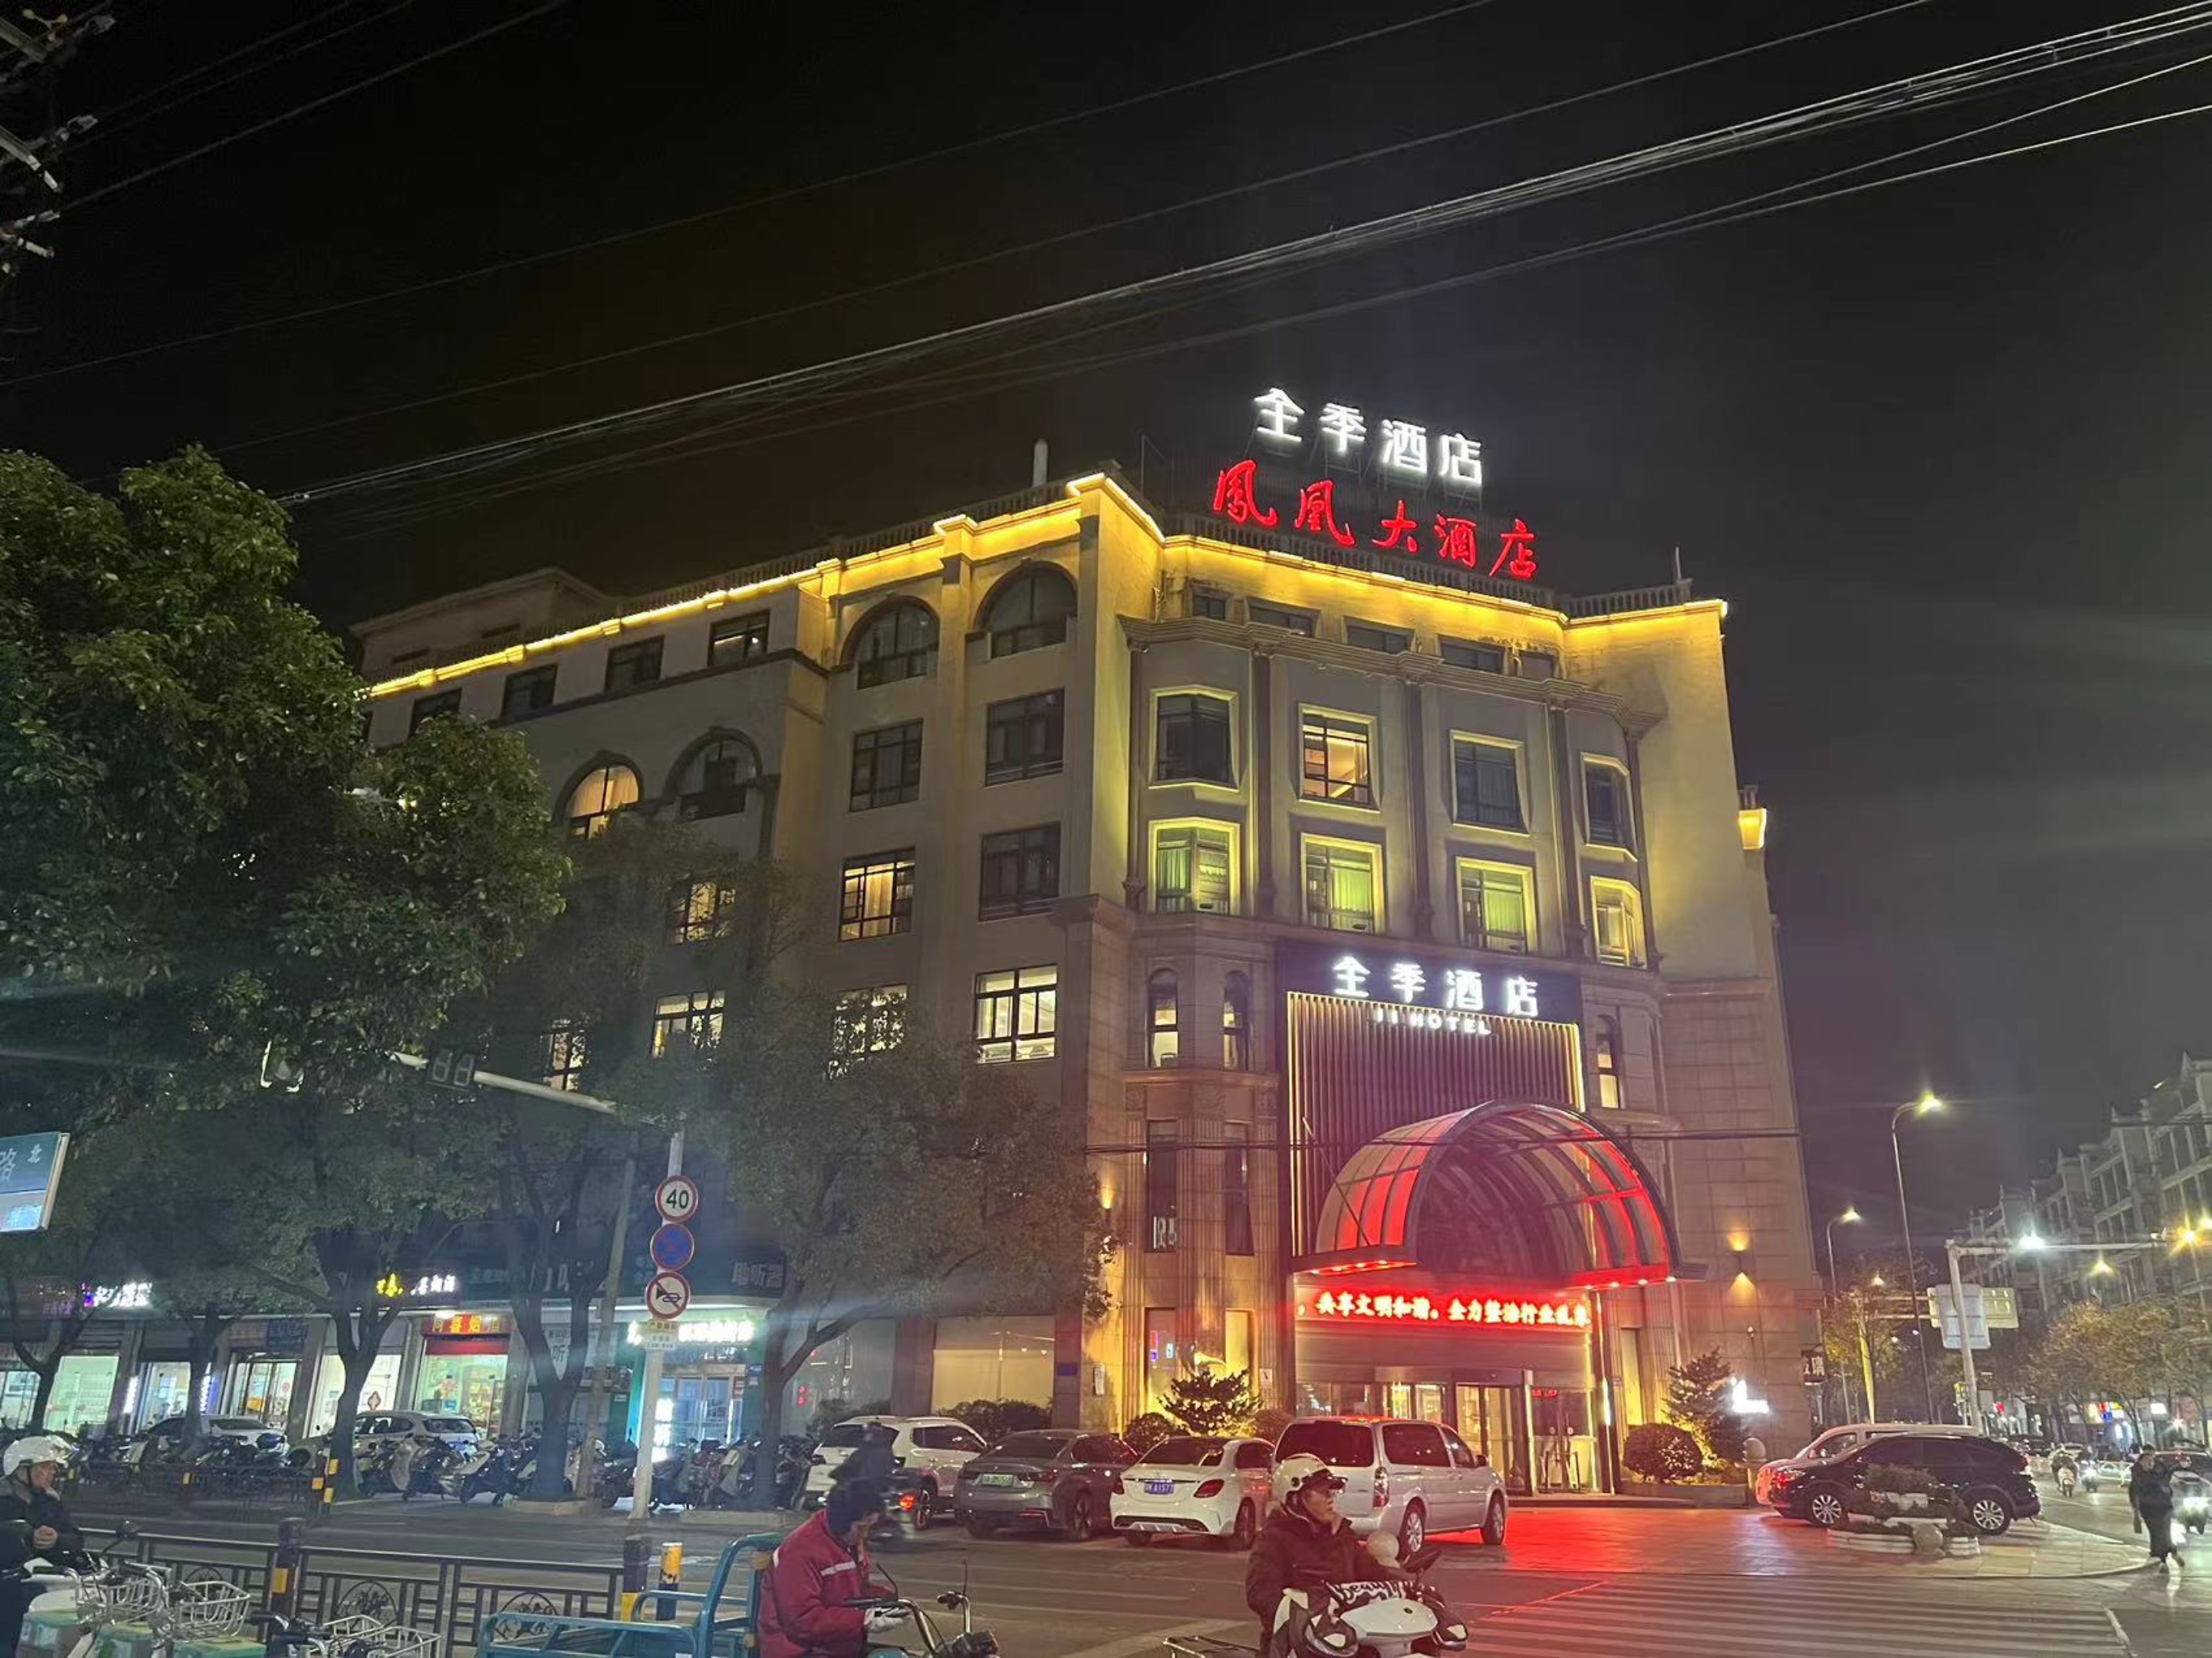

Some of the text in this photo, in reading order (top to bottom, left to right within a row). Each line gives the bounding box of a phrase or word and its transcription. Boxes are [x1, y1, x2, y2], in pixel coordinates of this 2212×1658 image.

[1253, 387, 1482, 484] 全季酒店
[1332, 955, 1539, 1018] 全季酒店
[1373, 1008, 1492, 1035] JI HOTEL
[28, 1143, 42, 1163] 北
[666, 1188, 689, 1209] 40
